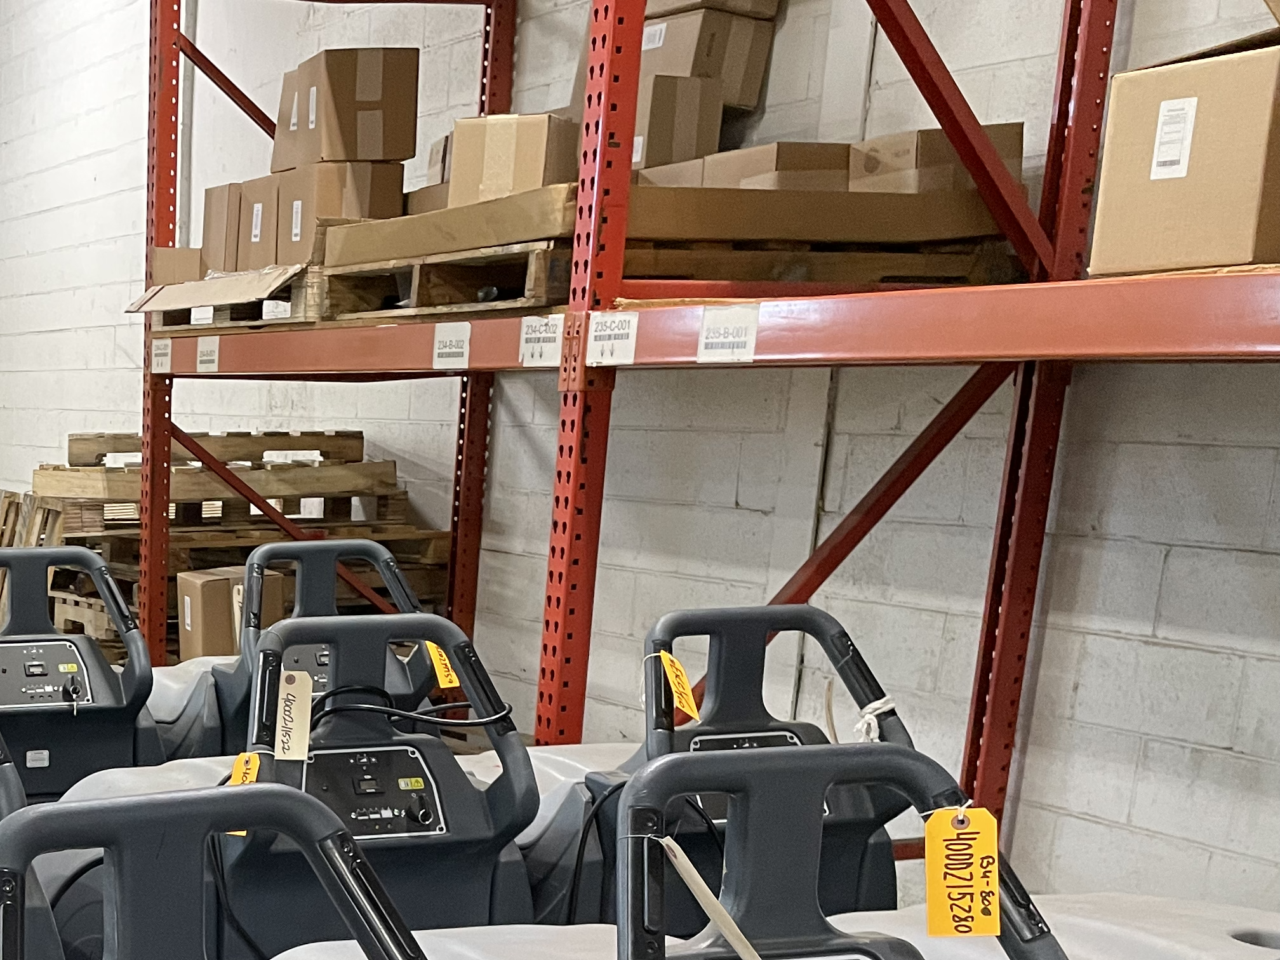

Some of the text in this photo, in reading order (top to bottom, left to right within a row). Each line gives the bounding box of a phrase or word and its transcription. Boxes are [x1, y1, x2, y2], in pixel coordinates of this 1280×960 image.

[525, 323, 558, 335] 234-C-002
[594, 318, 631, 333] 235-C-001
[705, 325, 749, 340] 235-B-001
[437, 339, 465, 350] 234-B-002
[942, 831, 981, 934] 4000215280
